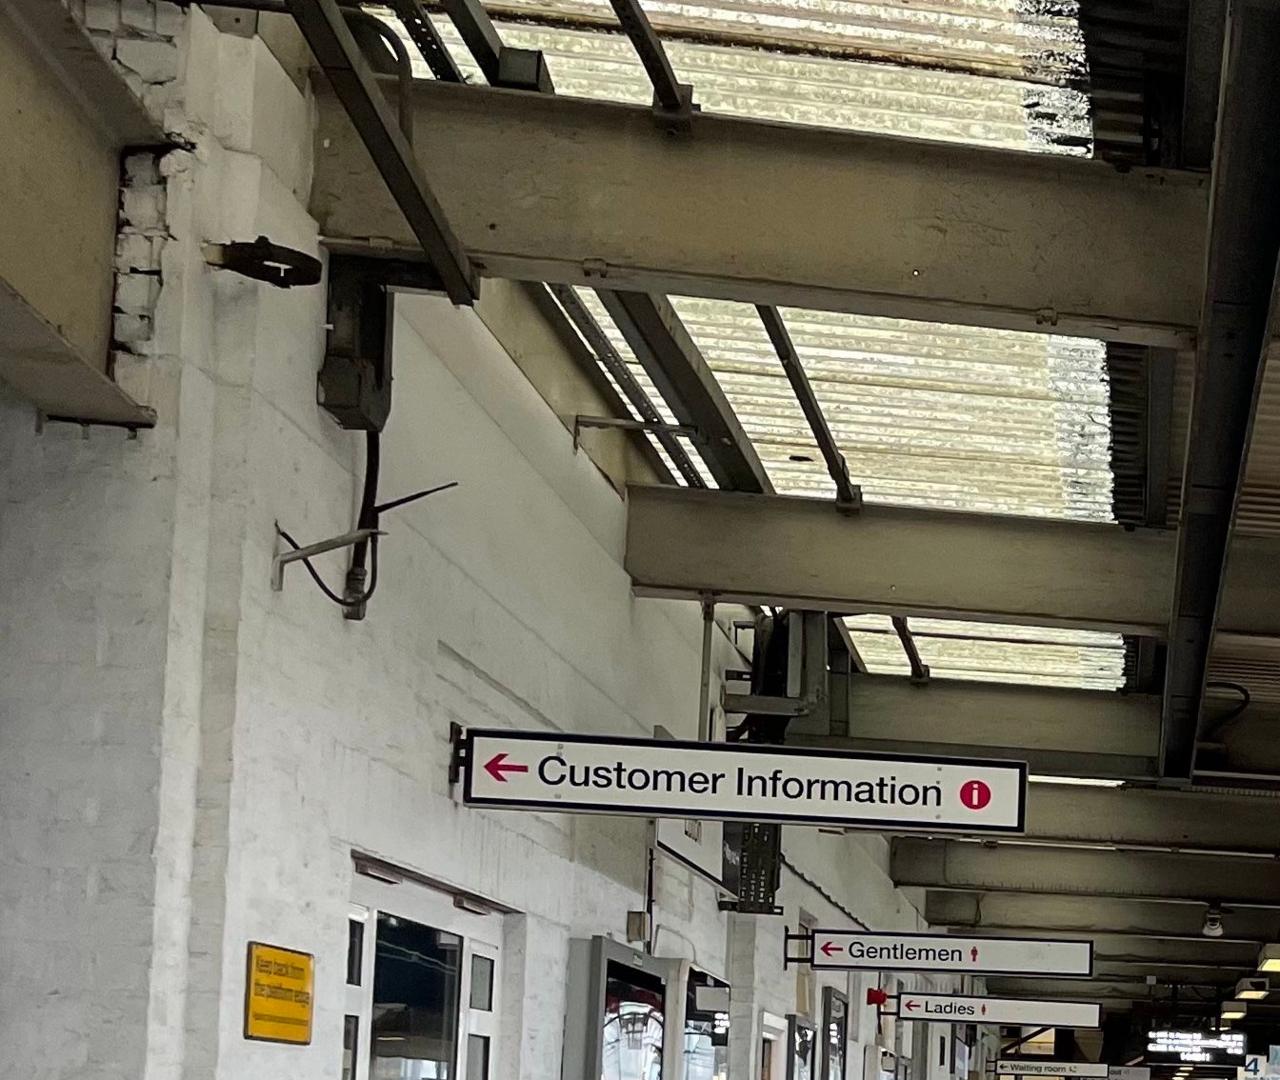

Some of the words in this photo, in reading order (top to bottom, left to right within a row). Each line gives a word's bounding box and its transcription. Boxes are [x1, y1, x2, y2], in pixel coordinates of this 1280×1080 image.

[538, 755, 725, 795] Customer
[737, 767, 942, 806] Information
[848, 941, 963, 962] Gentlemen
[924, 1001, 976, 1015] Ladies
[1010, 1063, 1043, 1073] Waiting
[1044, 1065, 1067, 1073] room
[1244, 1057, 1260, 1076] 4
